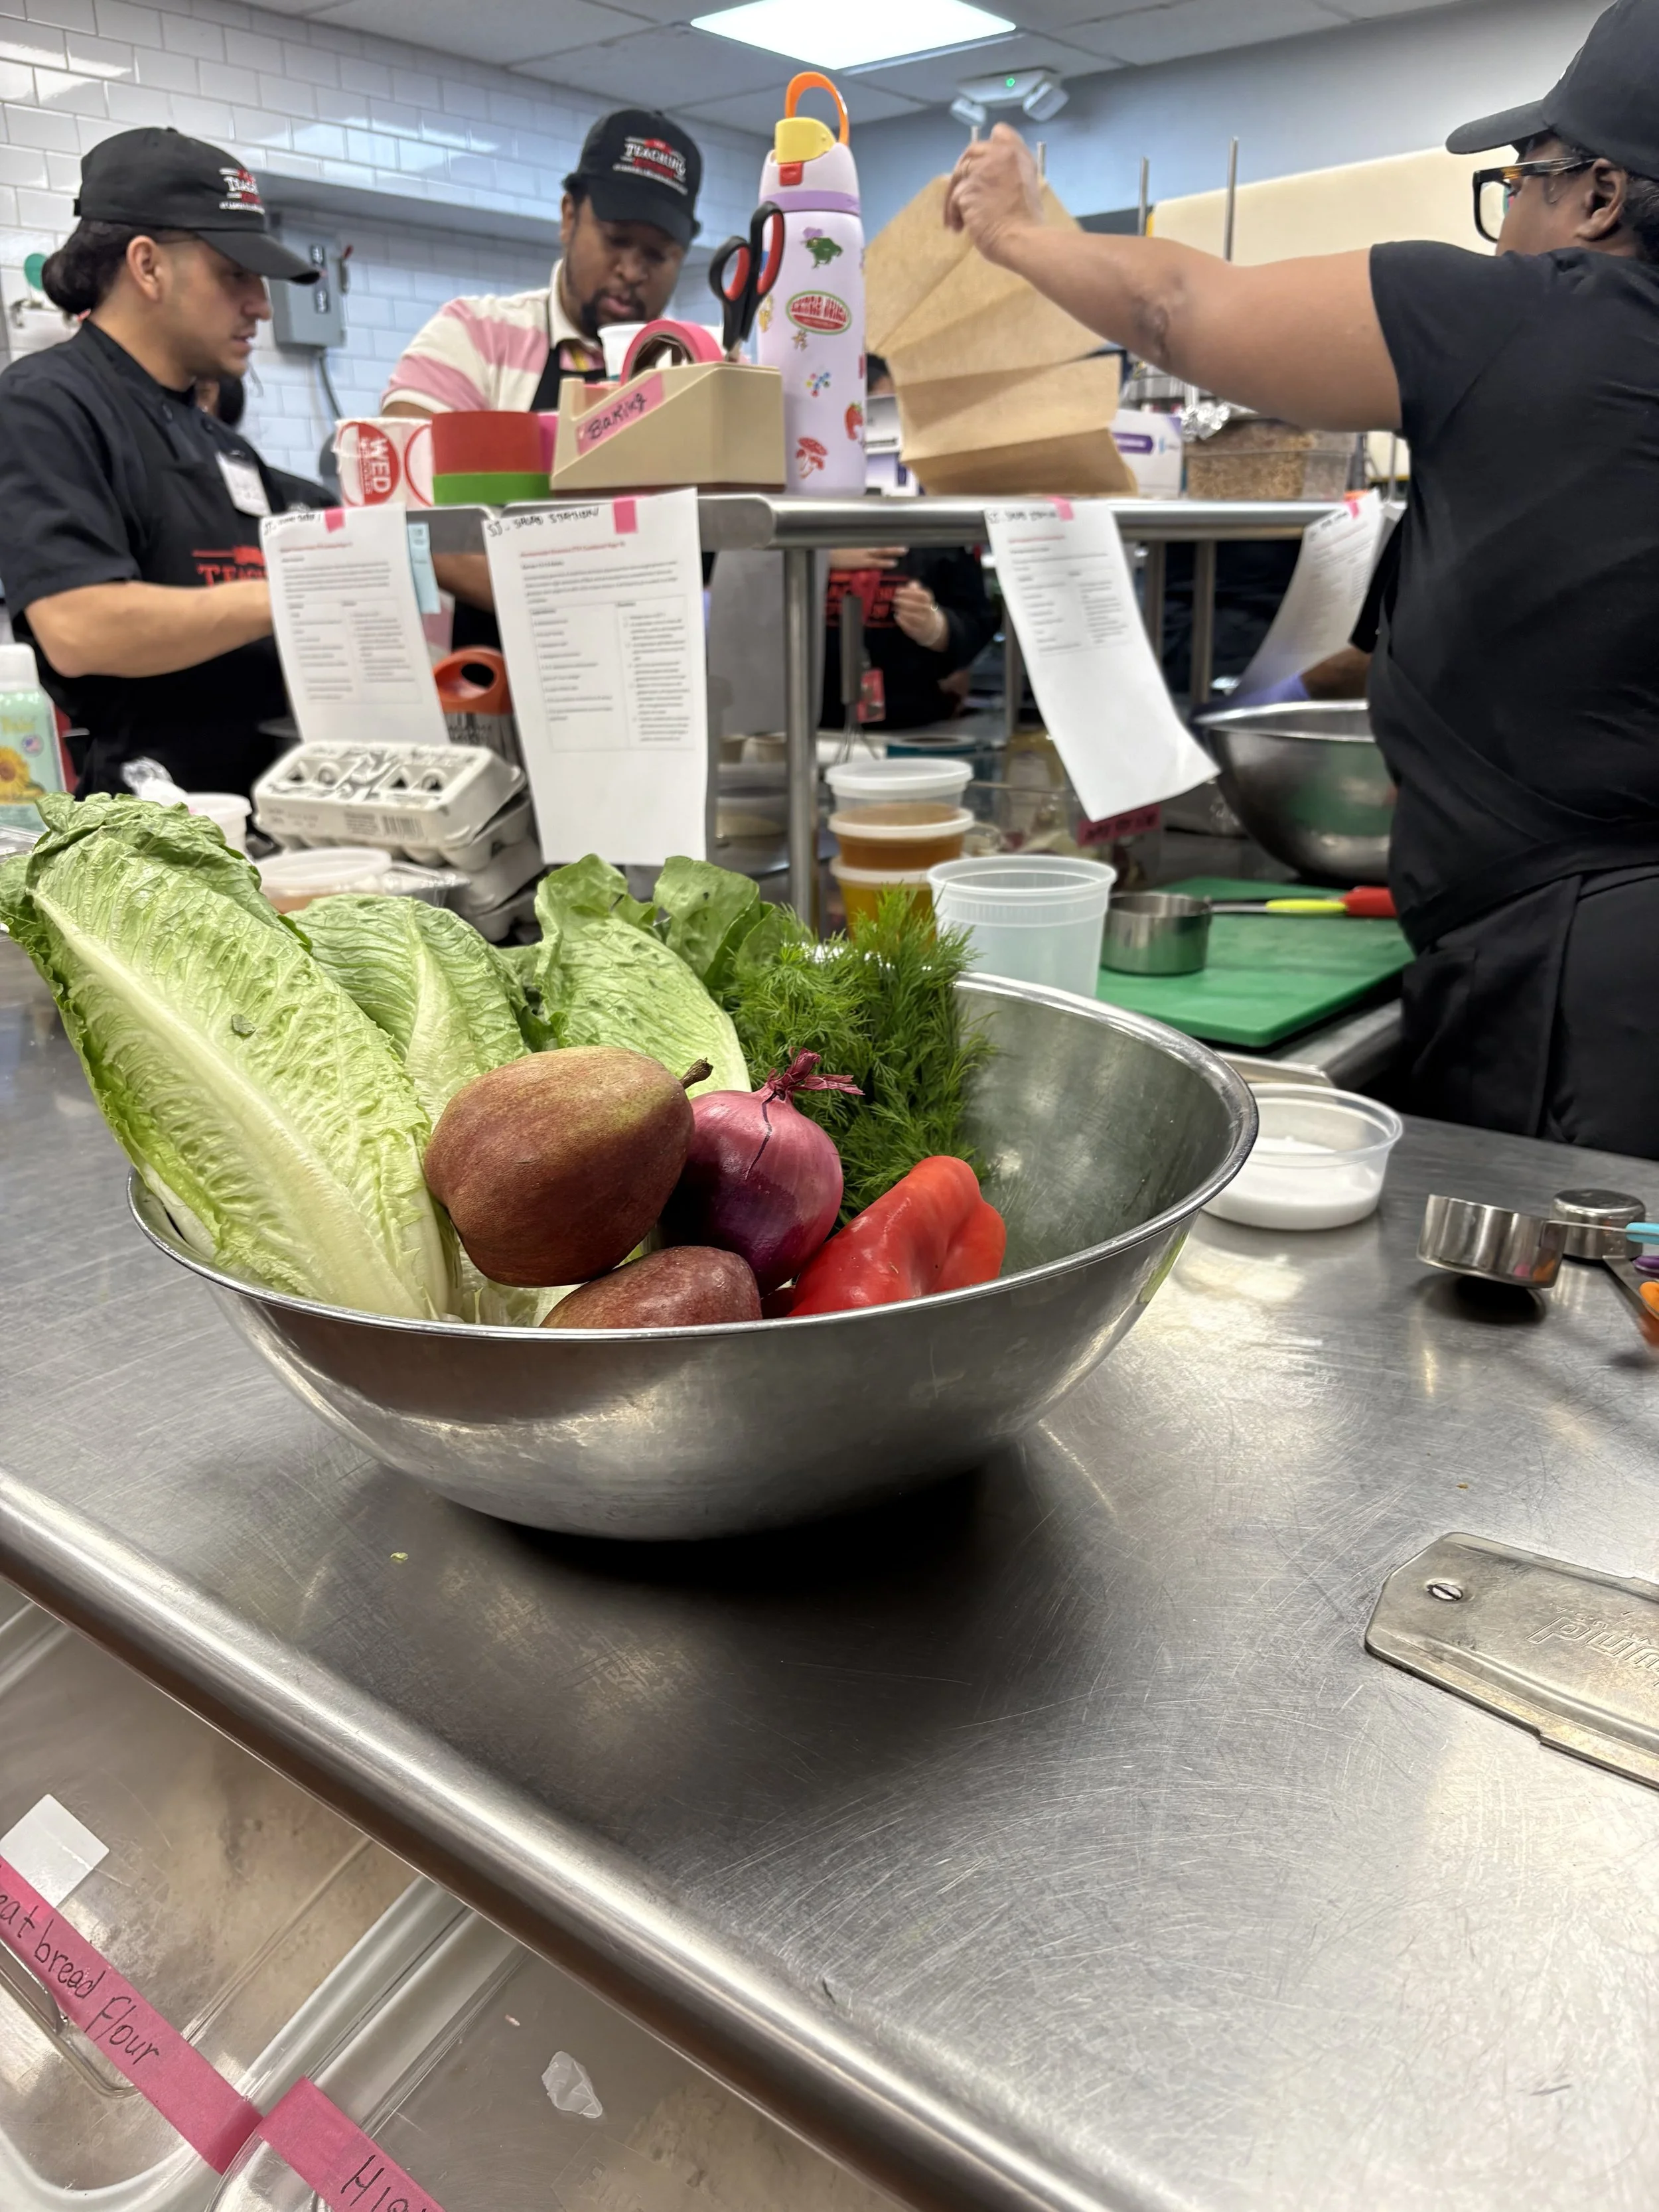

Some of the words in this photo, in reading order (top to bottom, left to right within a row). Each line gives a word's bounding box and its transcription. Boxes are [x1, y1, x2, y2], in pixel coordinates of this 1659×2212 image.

[370, 438, 392, 493] WED
[0, 1893, 40, 1939] eat
[34, 1918, 107, 2000] bread
